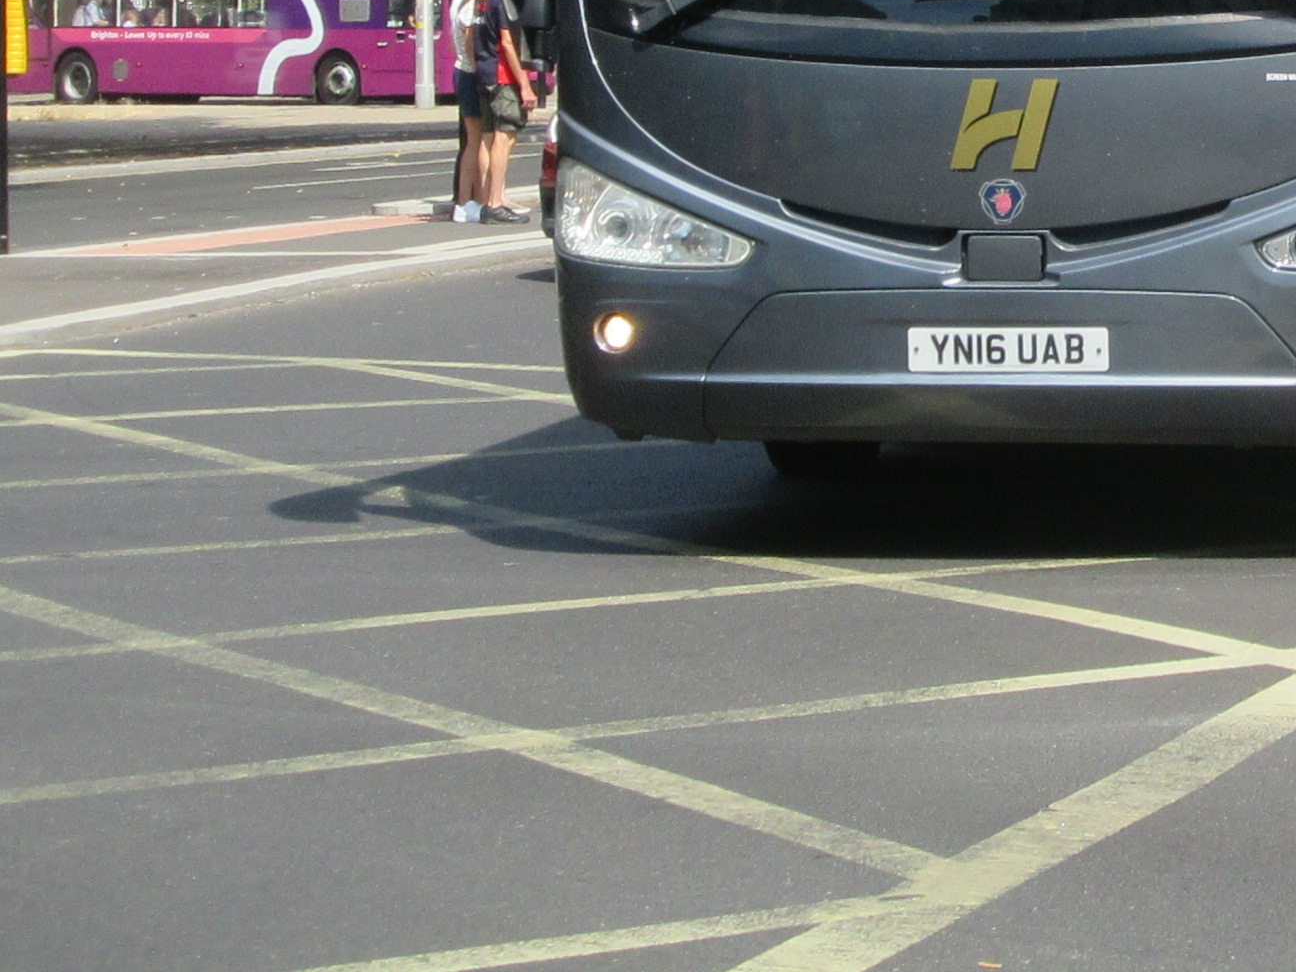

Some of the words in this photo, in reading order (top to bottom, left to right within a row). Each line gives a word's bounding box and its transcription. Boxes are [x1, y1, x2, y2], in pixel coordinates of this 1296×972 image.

[91, 31, 119, 40] Brighton
[931, 334, 1006, 364] YN16
[1018, 334, 1085, 363] UAB
